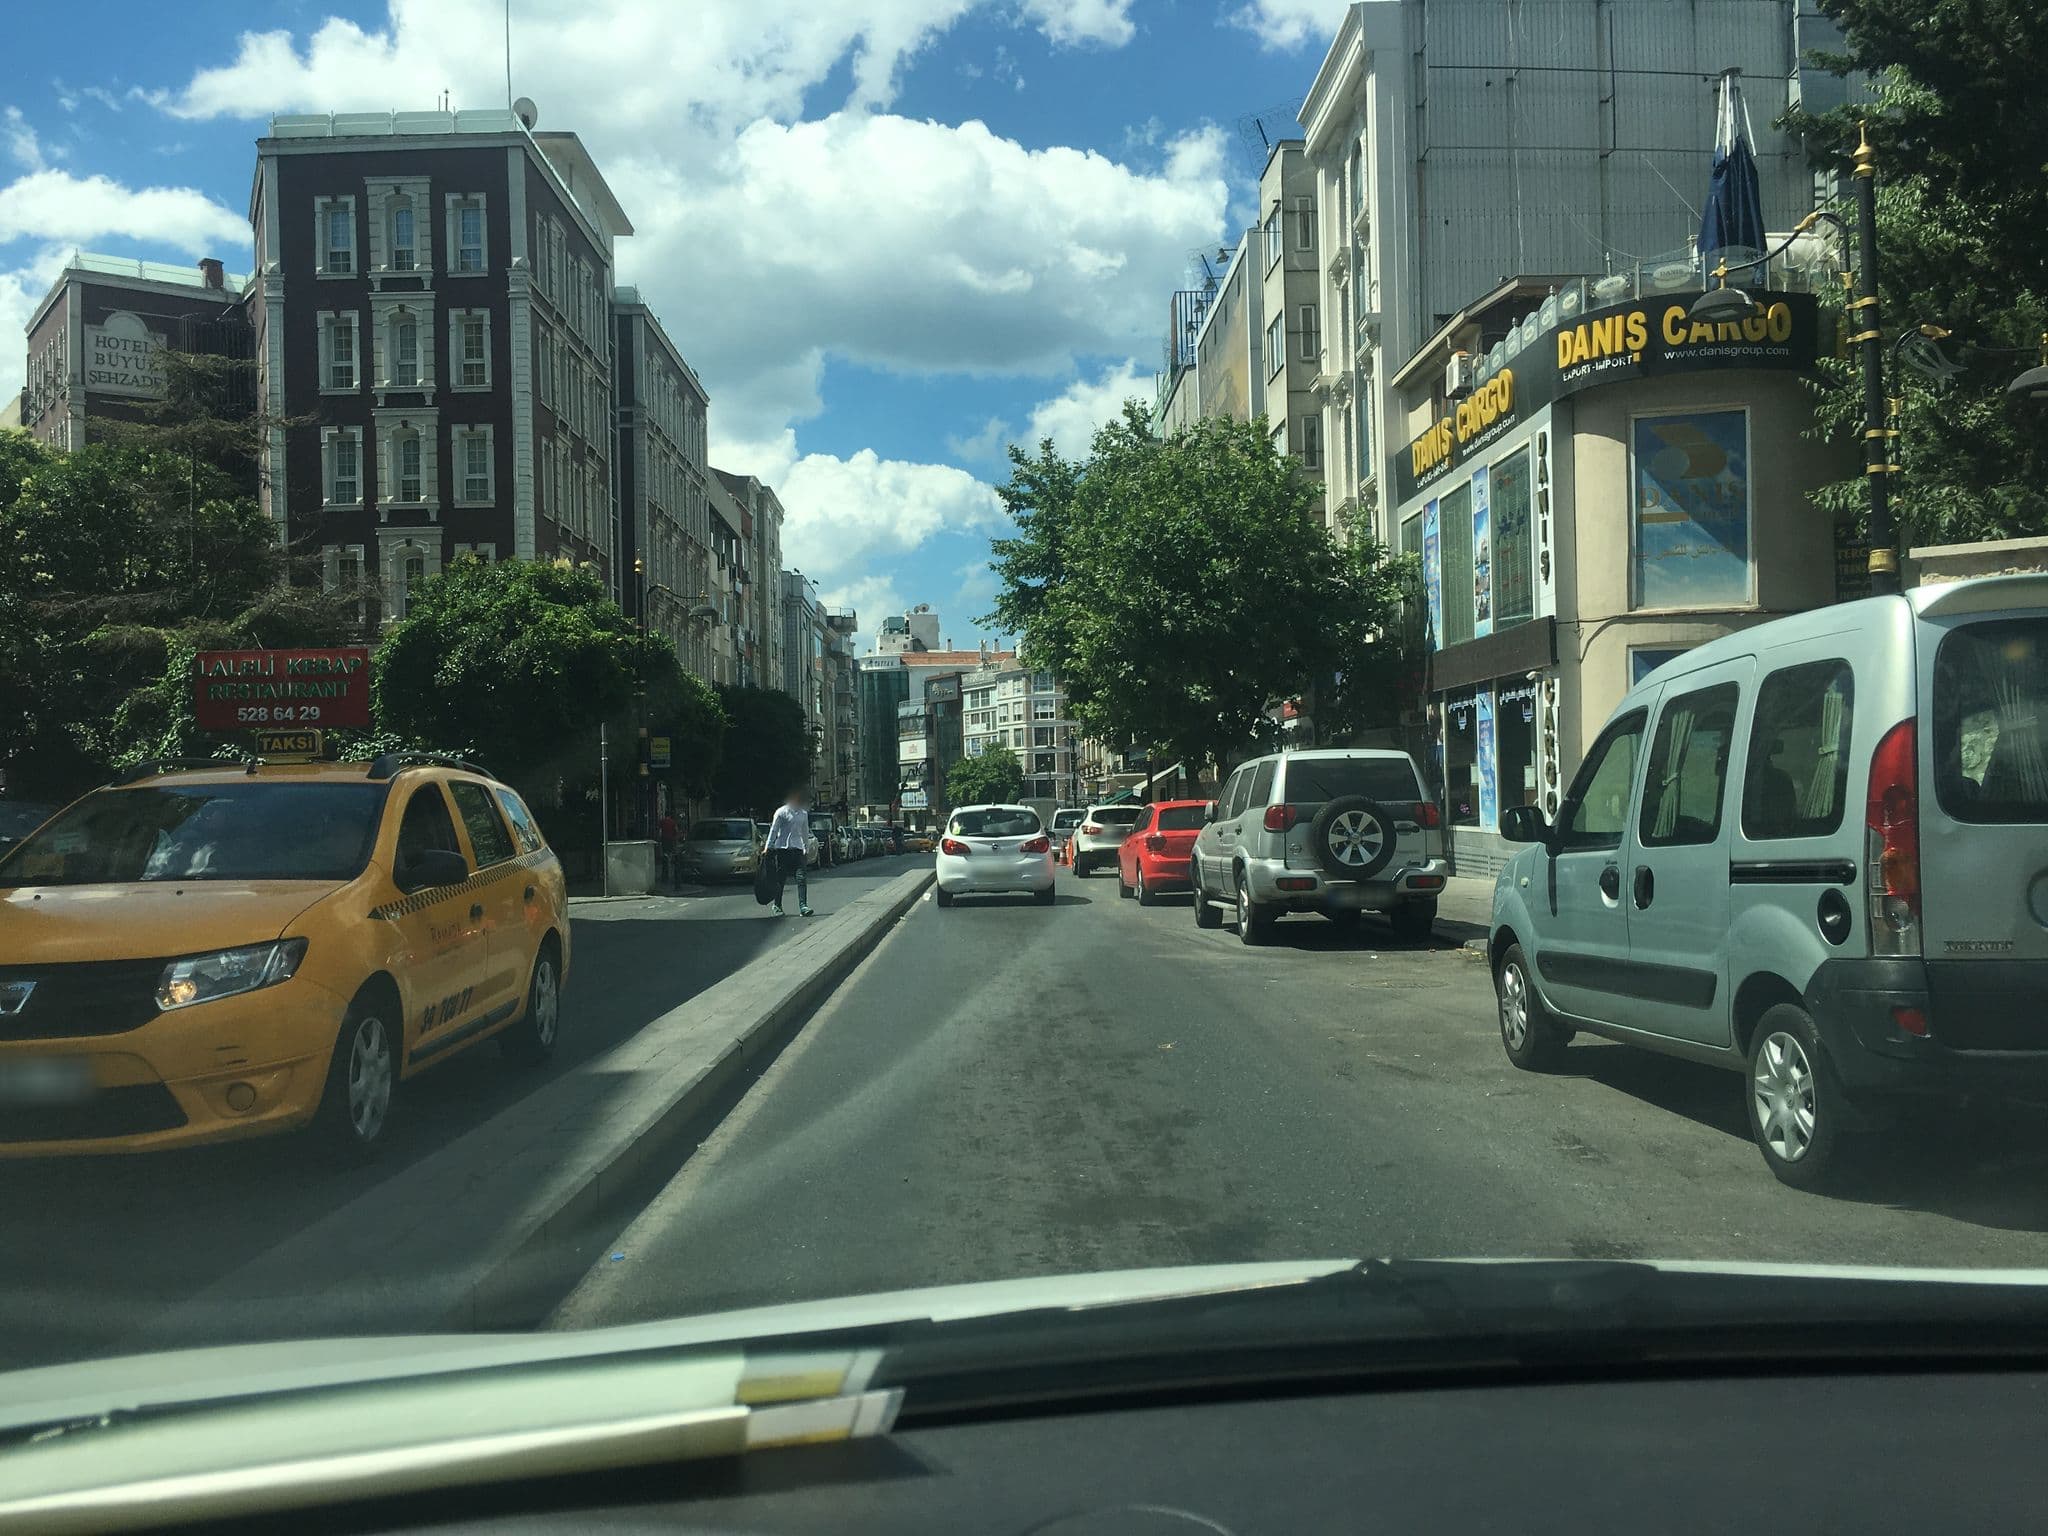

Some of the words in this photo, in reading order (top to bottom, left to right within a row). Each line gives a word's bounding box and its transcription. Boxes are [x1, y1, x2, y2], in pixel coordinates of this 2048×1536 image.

[95, 334, 151, 354] HOTEL
[1664, 346, 1790, 360] www.danisgroup.com
[1456, 368, 1514, 444] CARGO
[286, 656, 362, 676] KEBAP
[208, 681, 349, 700] RESTAURANT
[237, 706, 268, 722] 528
[273, 706, 295, 721] 64
[299, 705, 321, 721] 29
